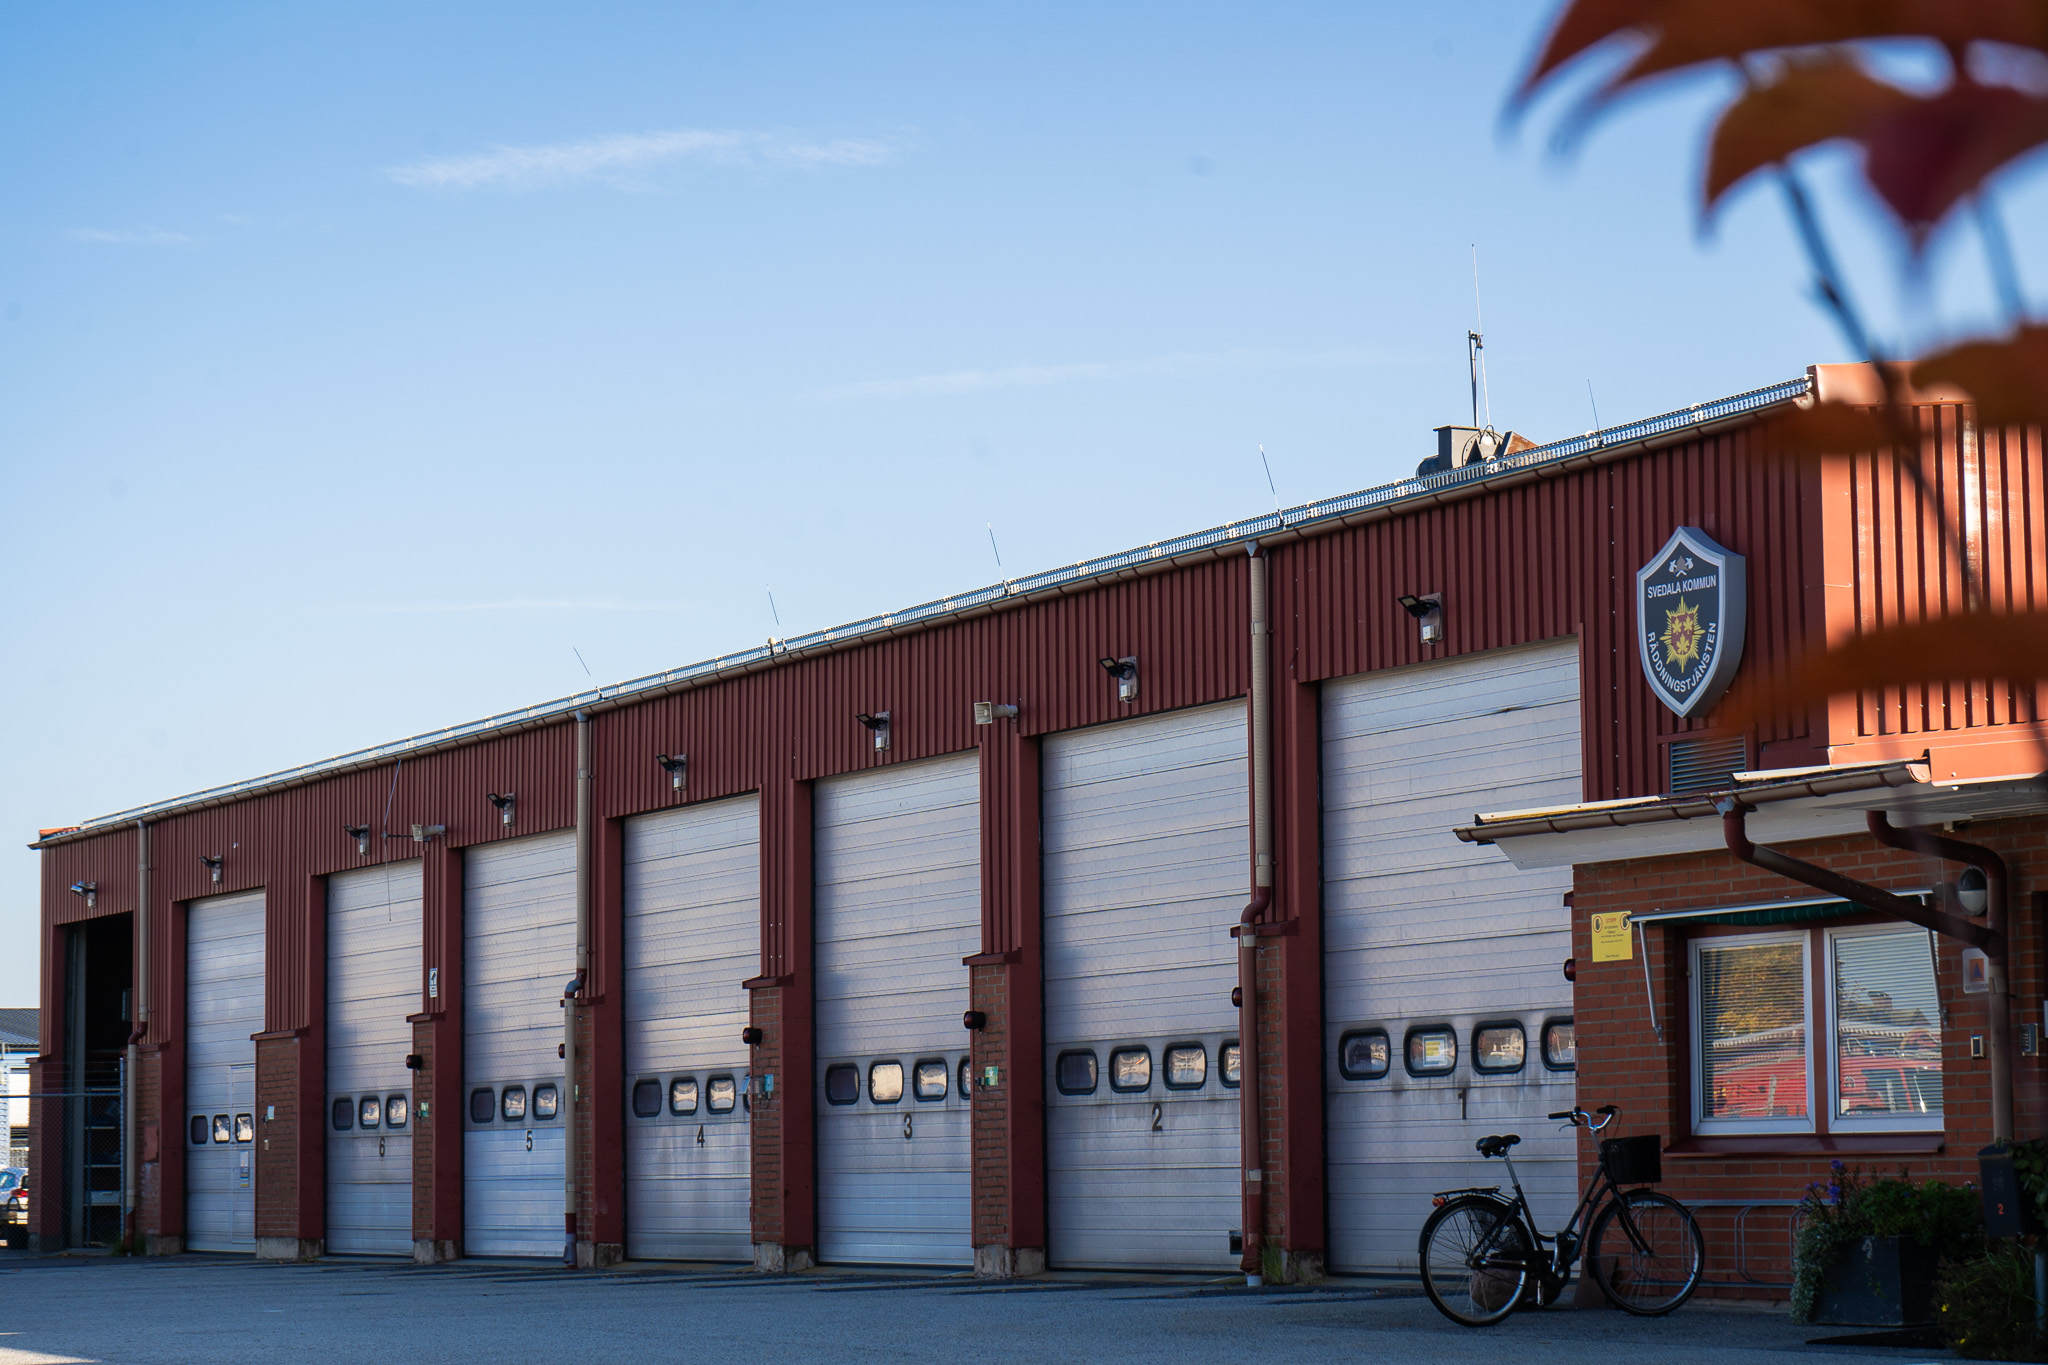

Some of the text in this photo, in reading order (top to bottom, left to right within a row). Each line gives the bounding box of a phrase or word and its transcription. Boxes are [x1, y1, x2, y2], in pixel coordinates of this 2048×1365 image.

[1647, 574, 1716, 599] SVEDALA KOMMUN
[1647, 622, 1717, 693] RÄDDNINGSTJÄNSTEN
[1457, 1087, 1467, 1120] 1
[903, 1112, 913, 1140] 3
[1151, 1102, 1163, 1132] 2
[378, 1136, 386, 1158] 6
[525, 1129, 533, 1152] 5
[696, 1124, 705, 1148] 4
[1997, 1203, 2005, 1215] 2
